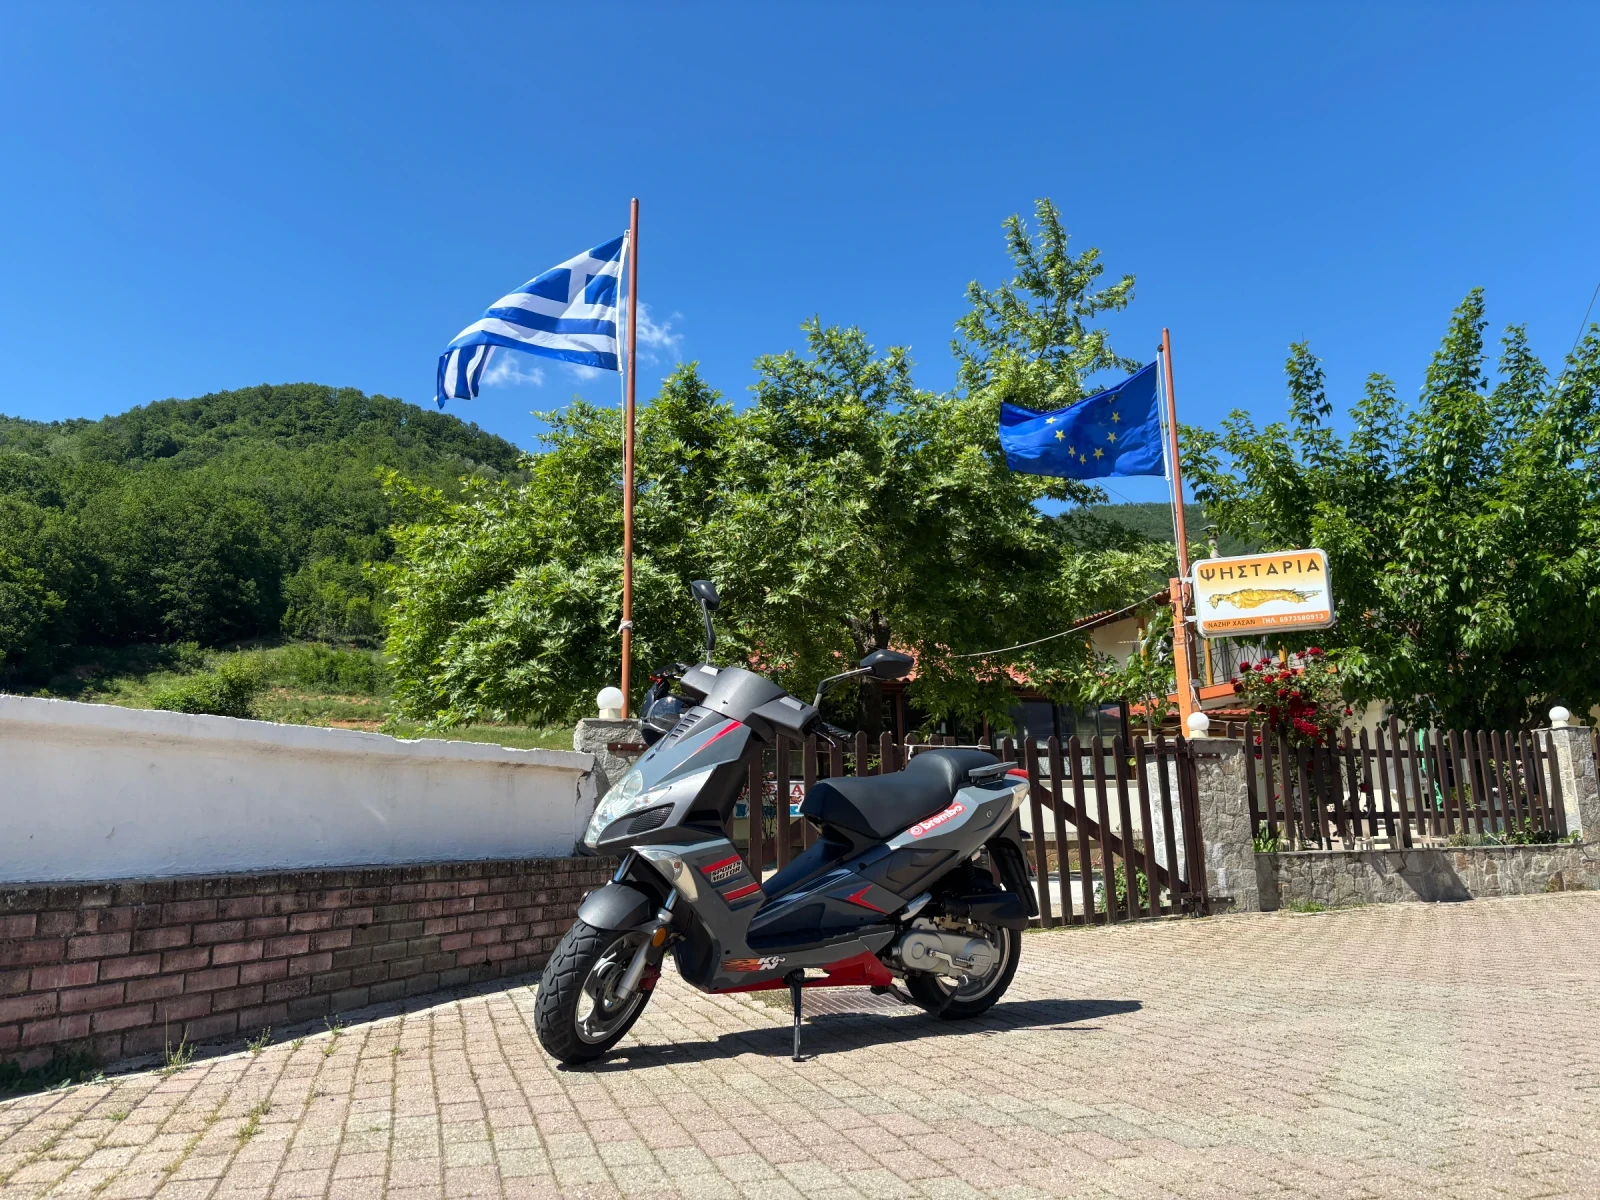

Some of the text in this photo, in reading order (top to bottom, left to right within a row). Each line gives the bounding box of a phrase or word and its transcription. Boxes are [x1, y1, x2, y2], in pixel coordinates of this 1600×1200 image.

[1200, 558, 1320, 581] ΨΗΣΤΑΡΙΑ
[1232, 619, 1256, 627] ΧΑΣΑΝ
[1279, 613, 1325, 623] 6973580913
[919, 804, 963, 830] brembo
[711, 861, 742, 876] SPORTS
[712, 866, 741, 882] MOTOR
